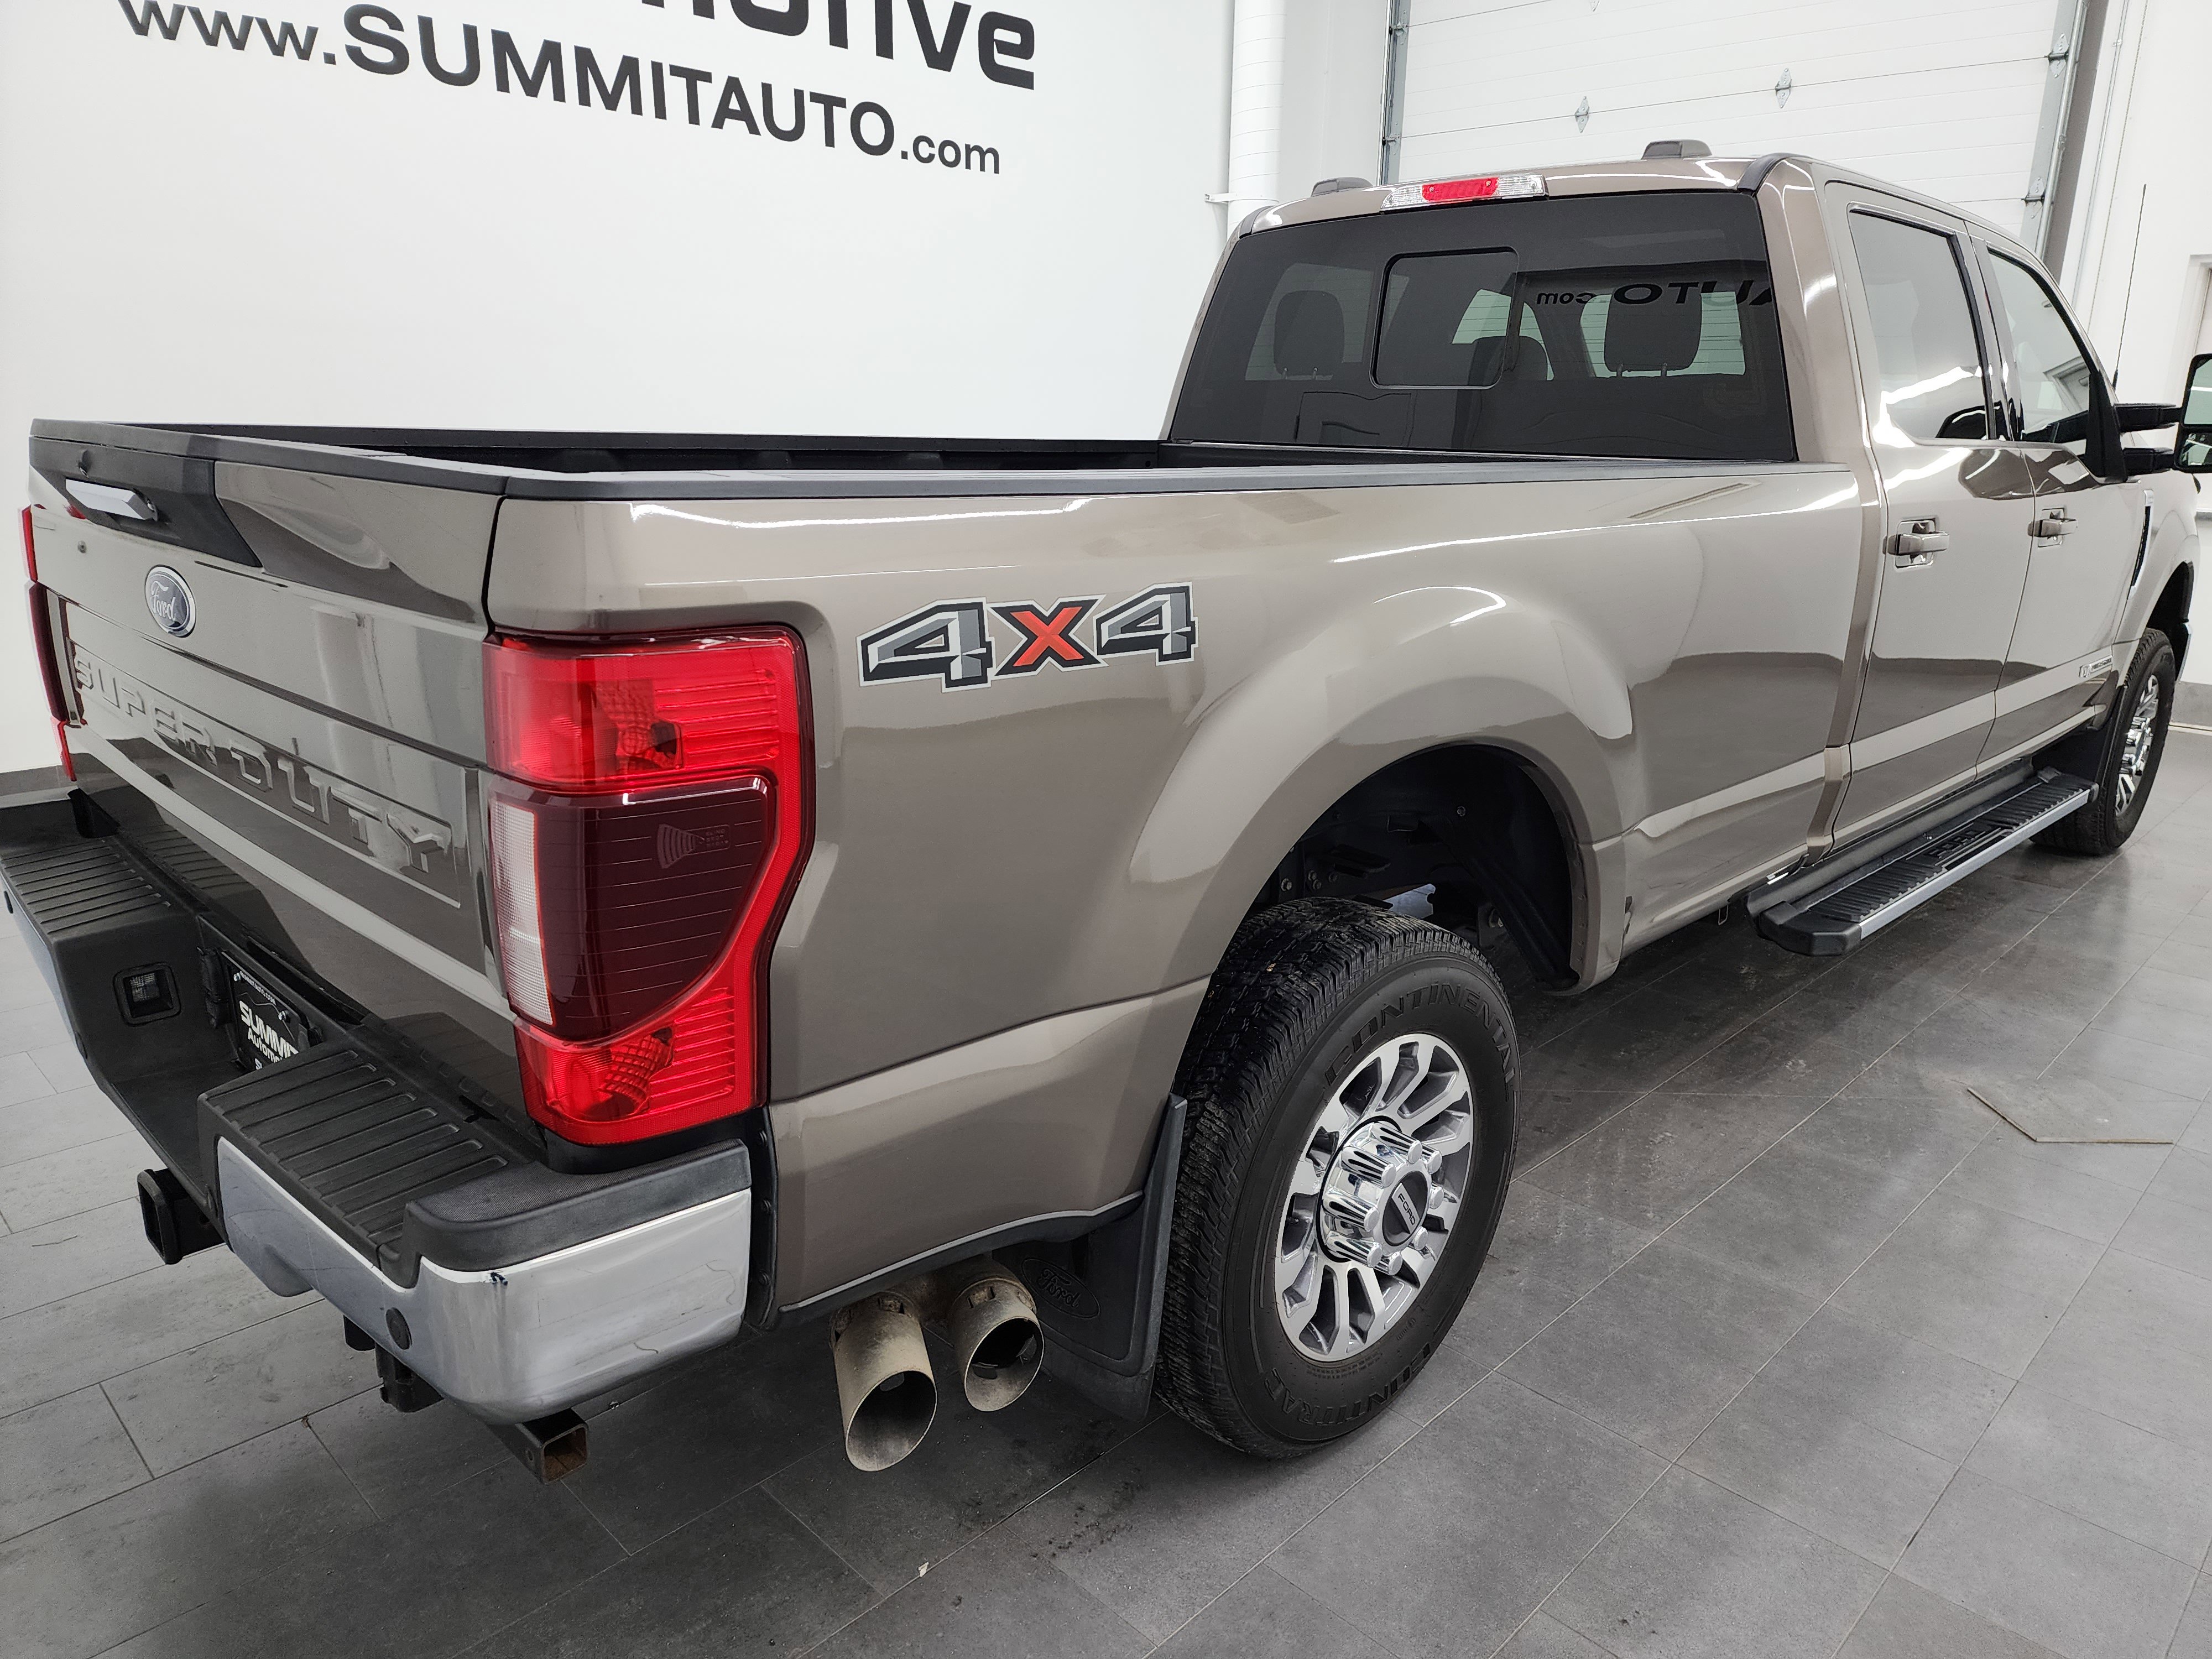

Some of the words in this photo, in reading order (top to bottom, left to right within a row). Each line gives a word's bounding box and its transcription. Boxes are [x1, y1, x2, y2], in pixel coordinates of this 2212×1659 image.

[119, 0, 1000, 174] www.SUMMITAUTO.com
[150, 580, 176, 621] Ford
[75, 653, 218, 766] SUPER
[231, 743, 448, 874] DUTY
[239, 1000, 299, 1058] SUMMI
[248, 1027, 283, 1063] Autom
[1324, 982, 1516, 1102] CONTINENTAL
[1397, 1193, 1416, 1225] FORD
[1036, 1267, 1081, 1308] Ford
